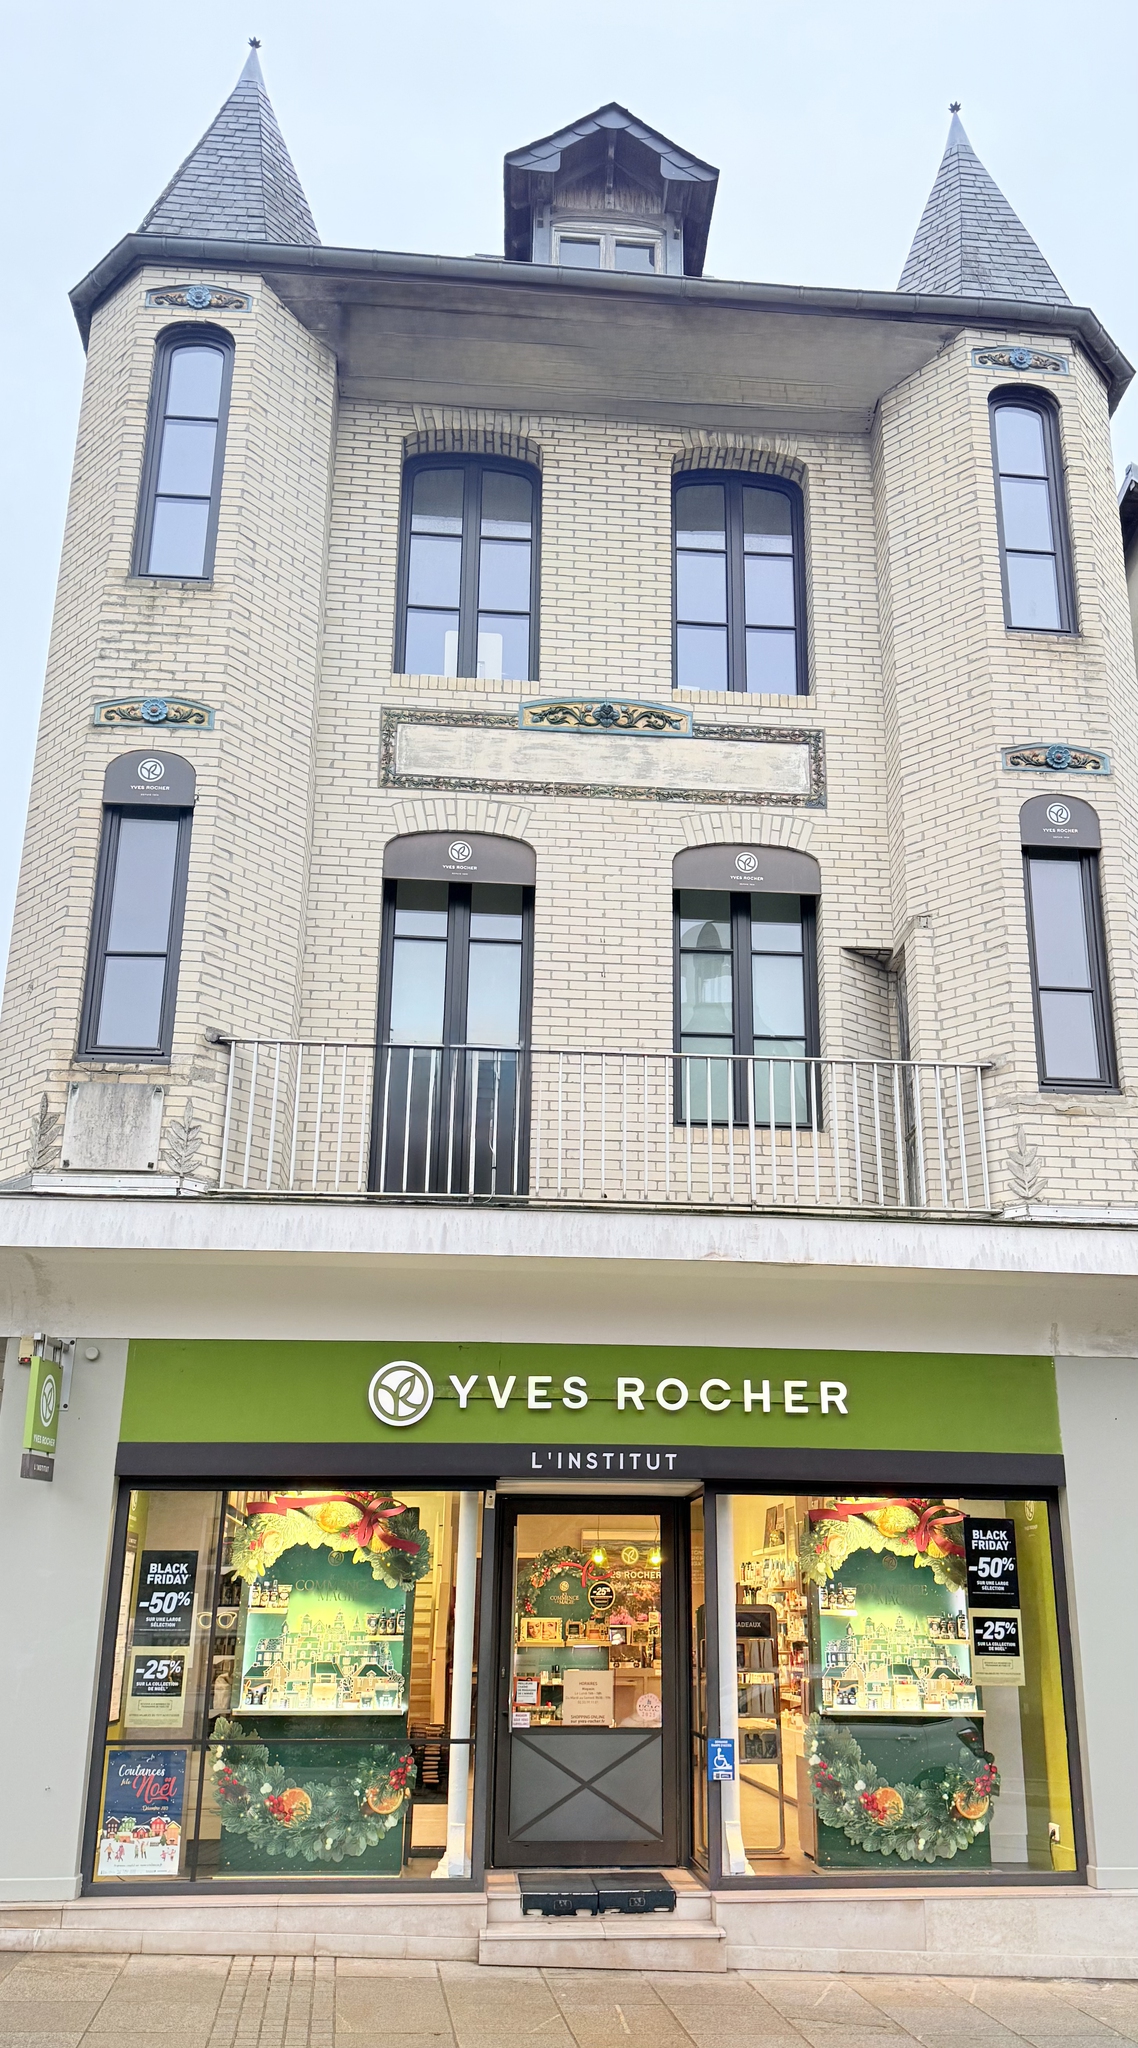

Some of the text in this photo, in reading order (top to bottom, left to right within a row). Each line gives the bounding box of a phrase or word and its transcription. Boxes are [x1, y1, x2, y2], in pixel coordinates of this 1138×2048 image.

[448, 1374, 849, 1415] YVES ROCHER
[530, 1451, 678, 1472] L'INSTITUT
[972, 1530, 1008, 1540] BLACK
[149, 1563, 188, 1574] BLACK
[624, 1571, 661, 1579] ROCHER
[118, 1763, 166, 1777] Coutances
[132, 1774, 178, 1804] Noël
